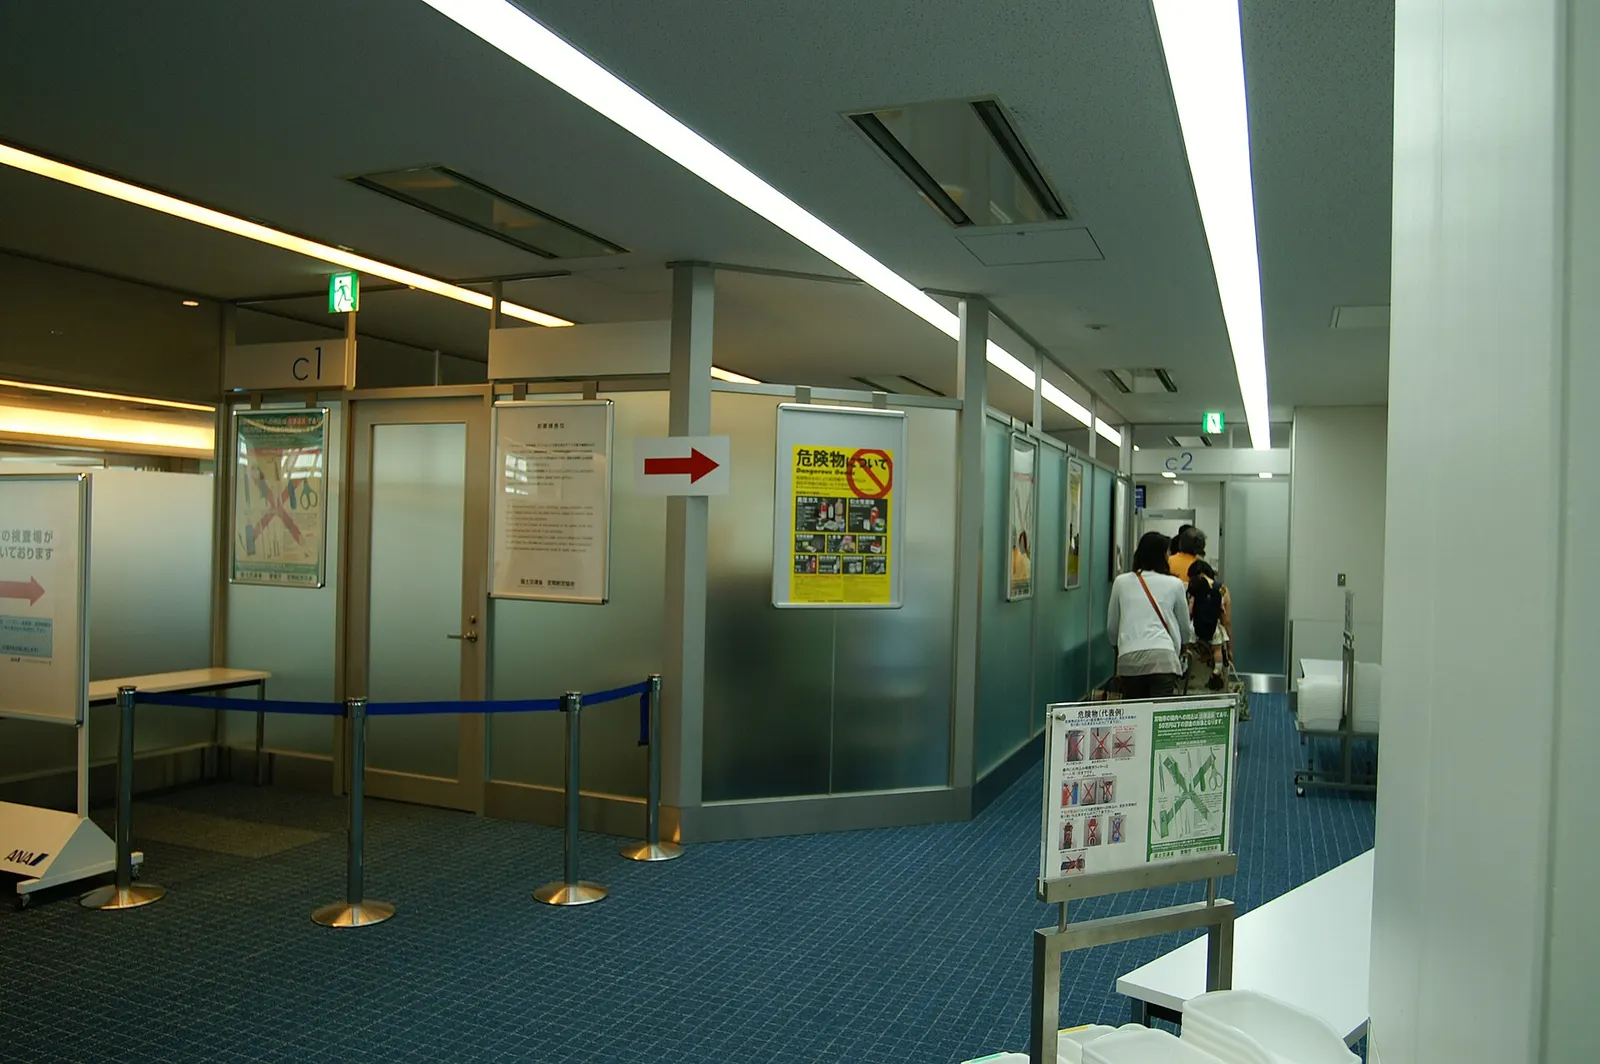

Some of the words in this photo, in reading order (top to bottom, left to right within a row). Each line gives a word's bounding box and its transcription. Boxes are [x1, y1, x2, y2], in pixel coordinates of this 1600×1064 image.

[293, 346, 321, 381] c1
[796, 448, 887, 470] 危険物について
[1165, 452, 1193, 471] c2
[795, 467, 832, 475] Dangerous
[1077, 708, 1125, 719] 危険物(代表例)
[4, 849, 34, 866] ANA
